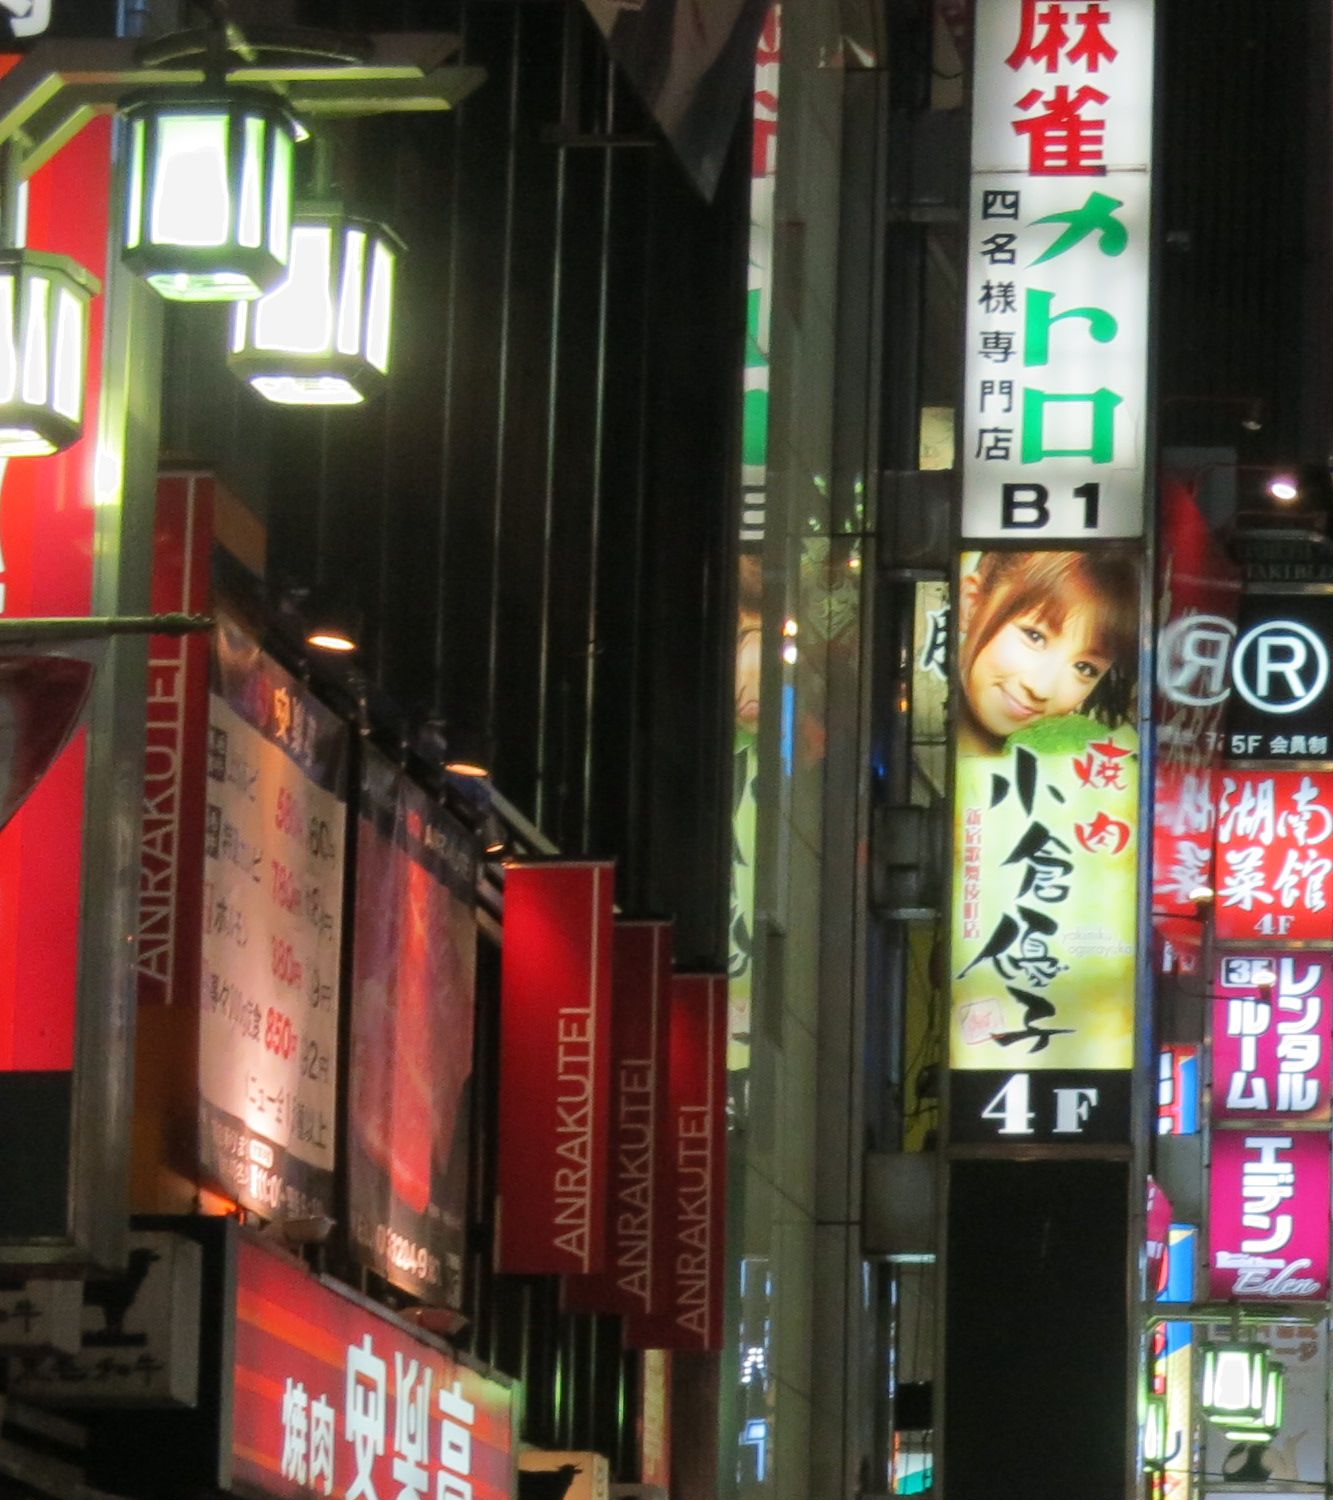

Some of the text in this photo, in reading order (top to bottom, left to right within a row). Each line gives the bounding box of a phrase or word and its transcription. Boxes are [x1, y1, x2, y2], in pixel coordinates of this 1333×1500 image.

[1005, 0, 1118, 177] 麻雀
[976, 190, 1020, 462] 四名様専門店
[1021, 192, 1128, 464] メトロ
[1002, 484, 1100, 529] B1
[1072, 738, 1133, 855] 焼肉
[1231, 735, 1327, 755] 5F 会員制
[136, 656, 182, 984] ANRAKUTEI
[1218, 777, 1333, 847] 湖南
[956, 747, 1076, 1054] 小倉優子
[1218, 848, 1332, 913] 菜館
[1254, 914, 1295, 935] 4F
[1226, 997, 1270, 1110] ルーム
[1276, 957, 1321, 1111] レンタル
[553, 1007, 593, 1257] ANRAKUTEI
[981, 1073, 1097, 1134] 4F
[618, 1060, 651, 1298] ANRAKUTEI
[676, 1106, 709, 1334] ANRAKUTEI
[1241, 1136, 1293, 1254] エデン
[1233, 1259, 1320, 1296] Eden
[280, 1377, 335, 1496] 焼肉
